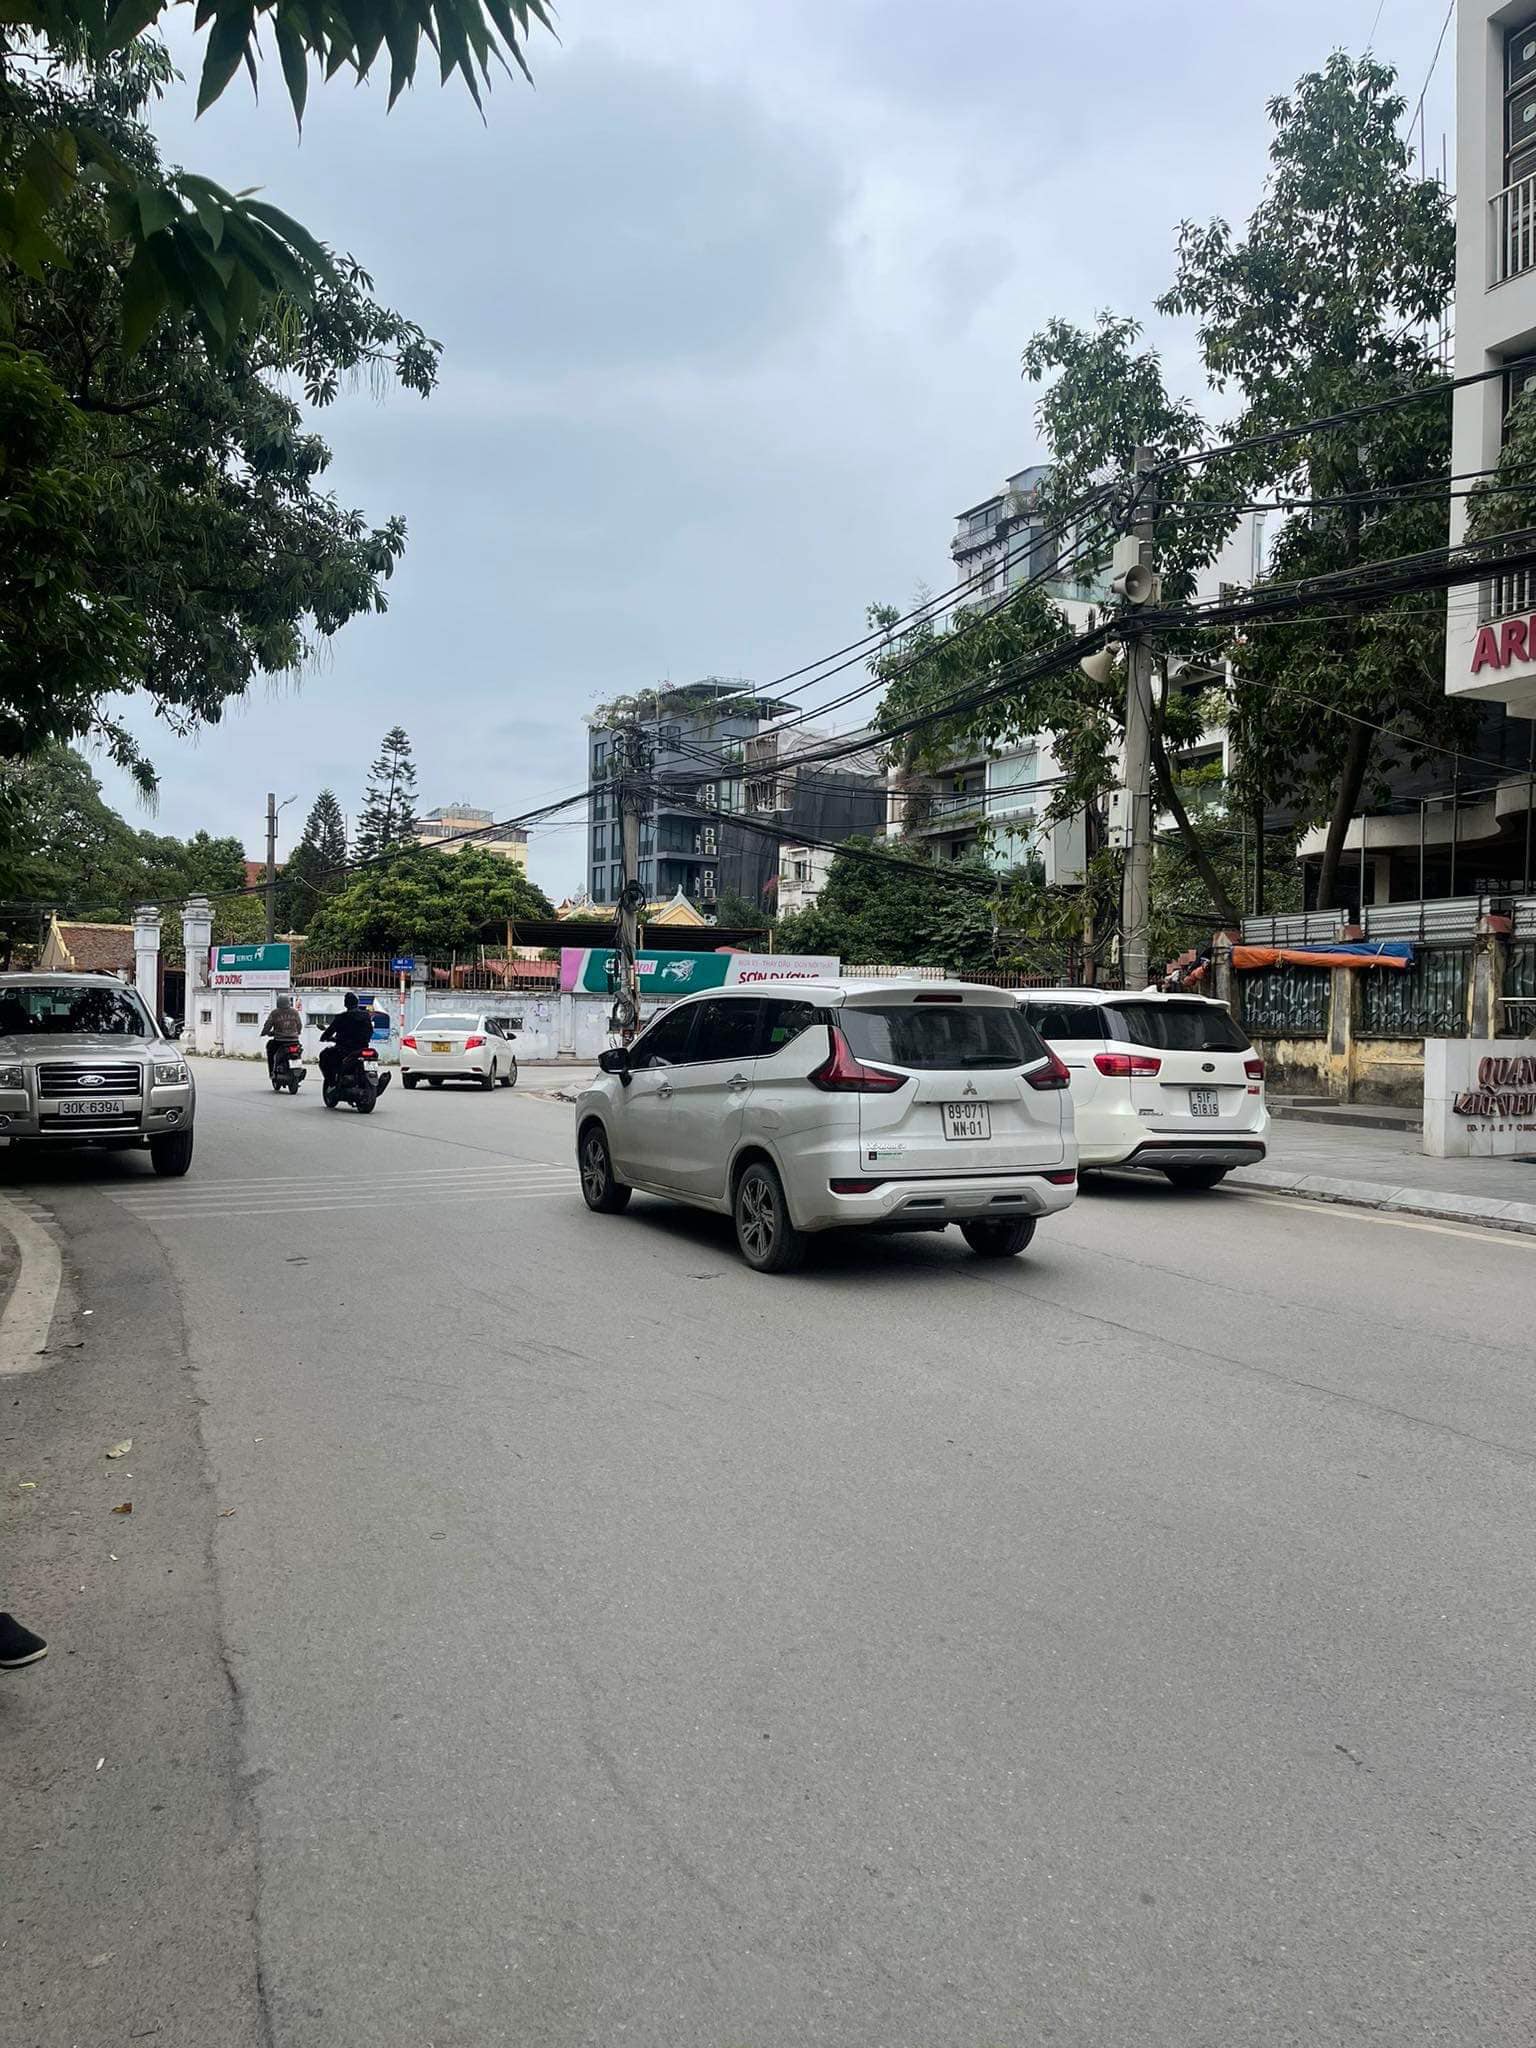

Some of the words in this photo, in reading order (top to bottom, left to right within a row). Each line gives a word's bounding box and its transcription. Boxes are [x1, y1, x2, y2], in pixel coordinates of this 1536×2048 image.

[1471, 614, 1536, 675] AR
[1196, 1092, 1212, 1103] 51F
[948, 1103, 984, 1119] 89-071
[952, 1120, 983, 1136] NN-01
